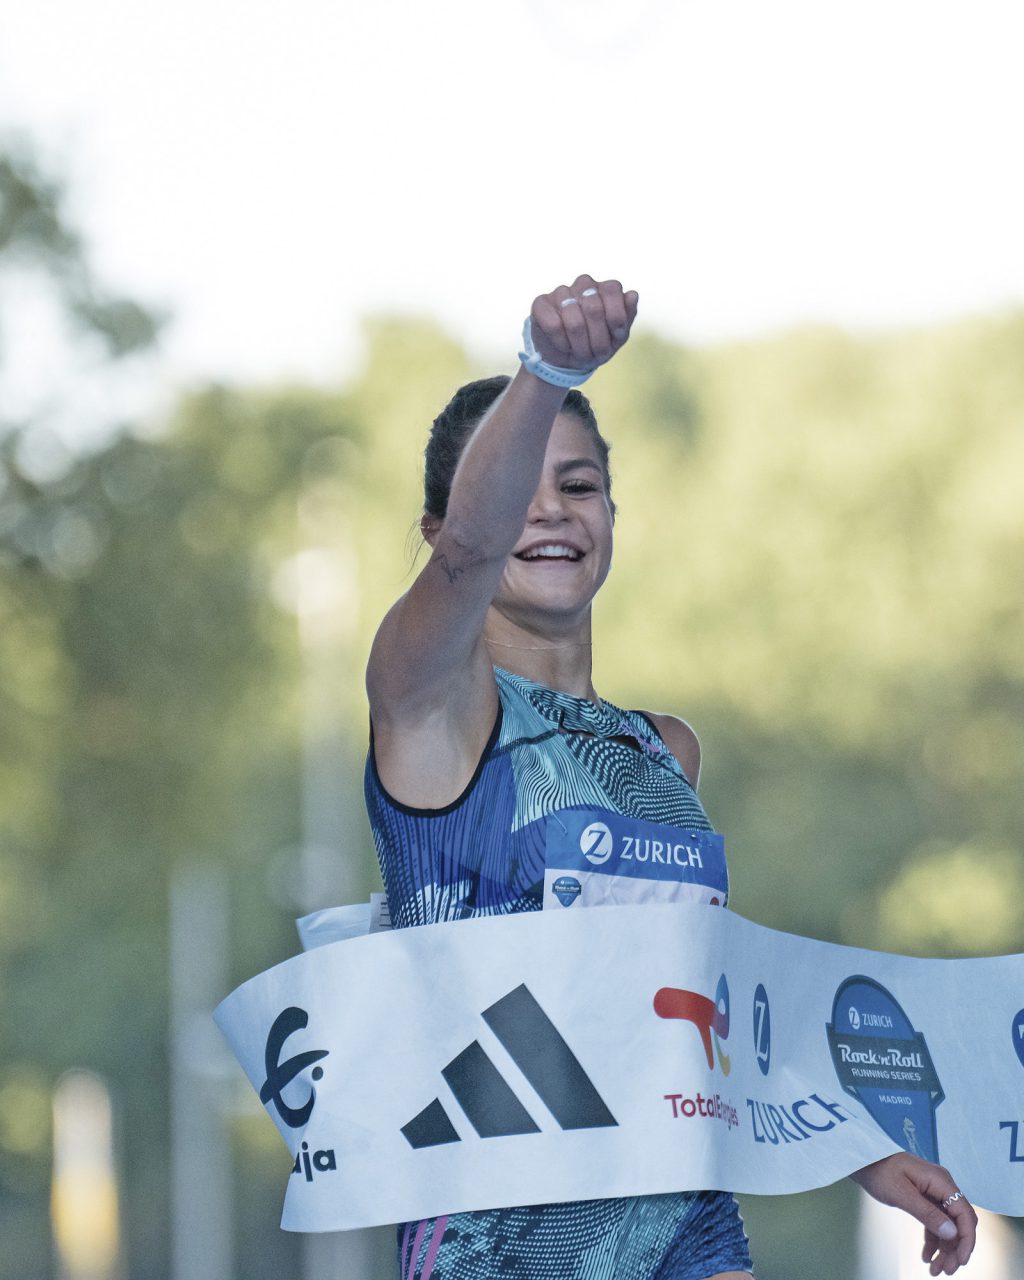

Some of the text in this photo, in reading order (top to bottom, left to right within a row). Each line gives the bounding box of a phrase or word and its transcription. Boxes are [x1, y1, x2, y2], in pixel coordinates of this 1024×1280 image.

[619, 836, 704, 868] ZURICH
[861, 1013, 893, 1028] ZURICH
[851, 1068, 921, 1081] RUNNING SERIES
[878, 1095, 912, 1105] MADRID
